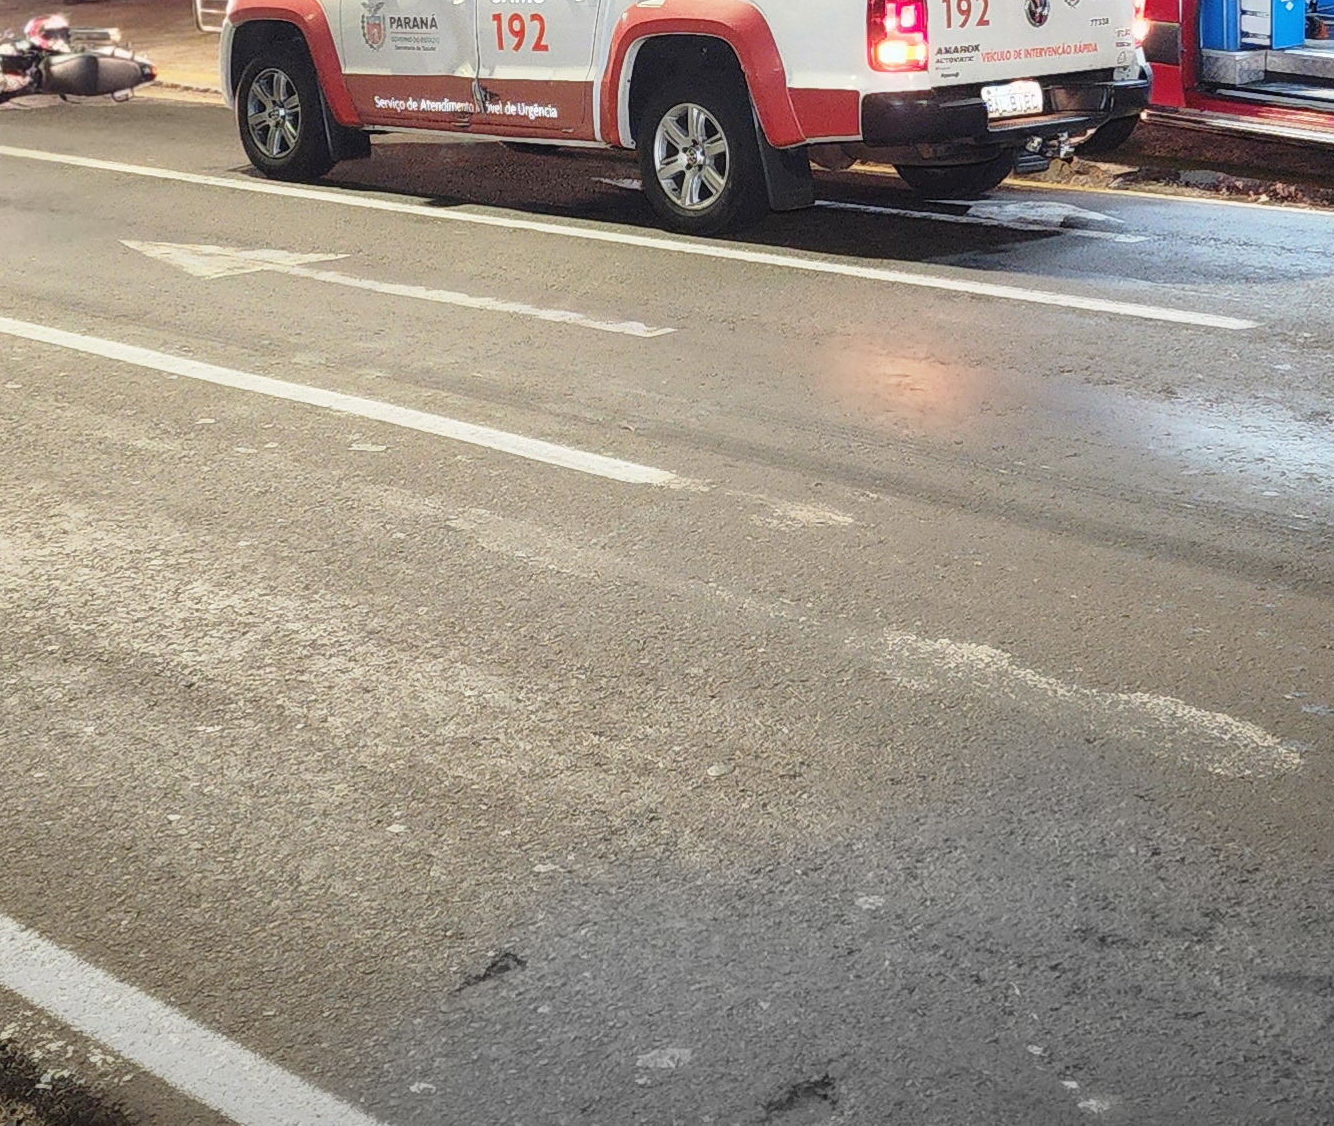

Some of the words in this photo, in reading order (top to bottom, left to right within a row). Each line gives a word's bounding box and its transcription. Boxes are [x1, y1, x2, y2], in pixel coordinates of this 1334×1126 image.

[388, 13, 439, 30] PARANÁ
[491, 12, 550, 53] 192
[980, 48, 1012, 63] VEÍCULO
[1013, 48, 1023, 60] DE
[1023, 42, 1073, 58] INTERVENÇÃO
[1073, 41, 1099, 55] RÁPIDA
[374, 95, 406, 113] Serviço
[407, 96, 419, 111] de
[420, 97, 475, 112] Atendimento
[504, 100, 517, 116] de
[518, 102, 559, 121] Urgência
